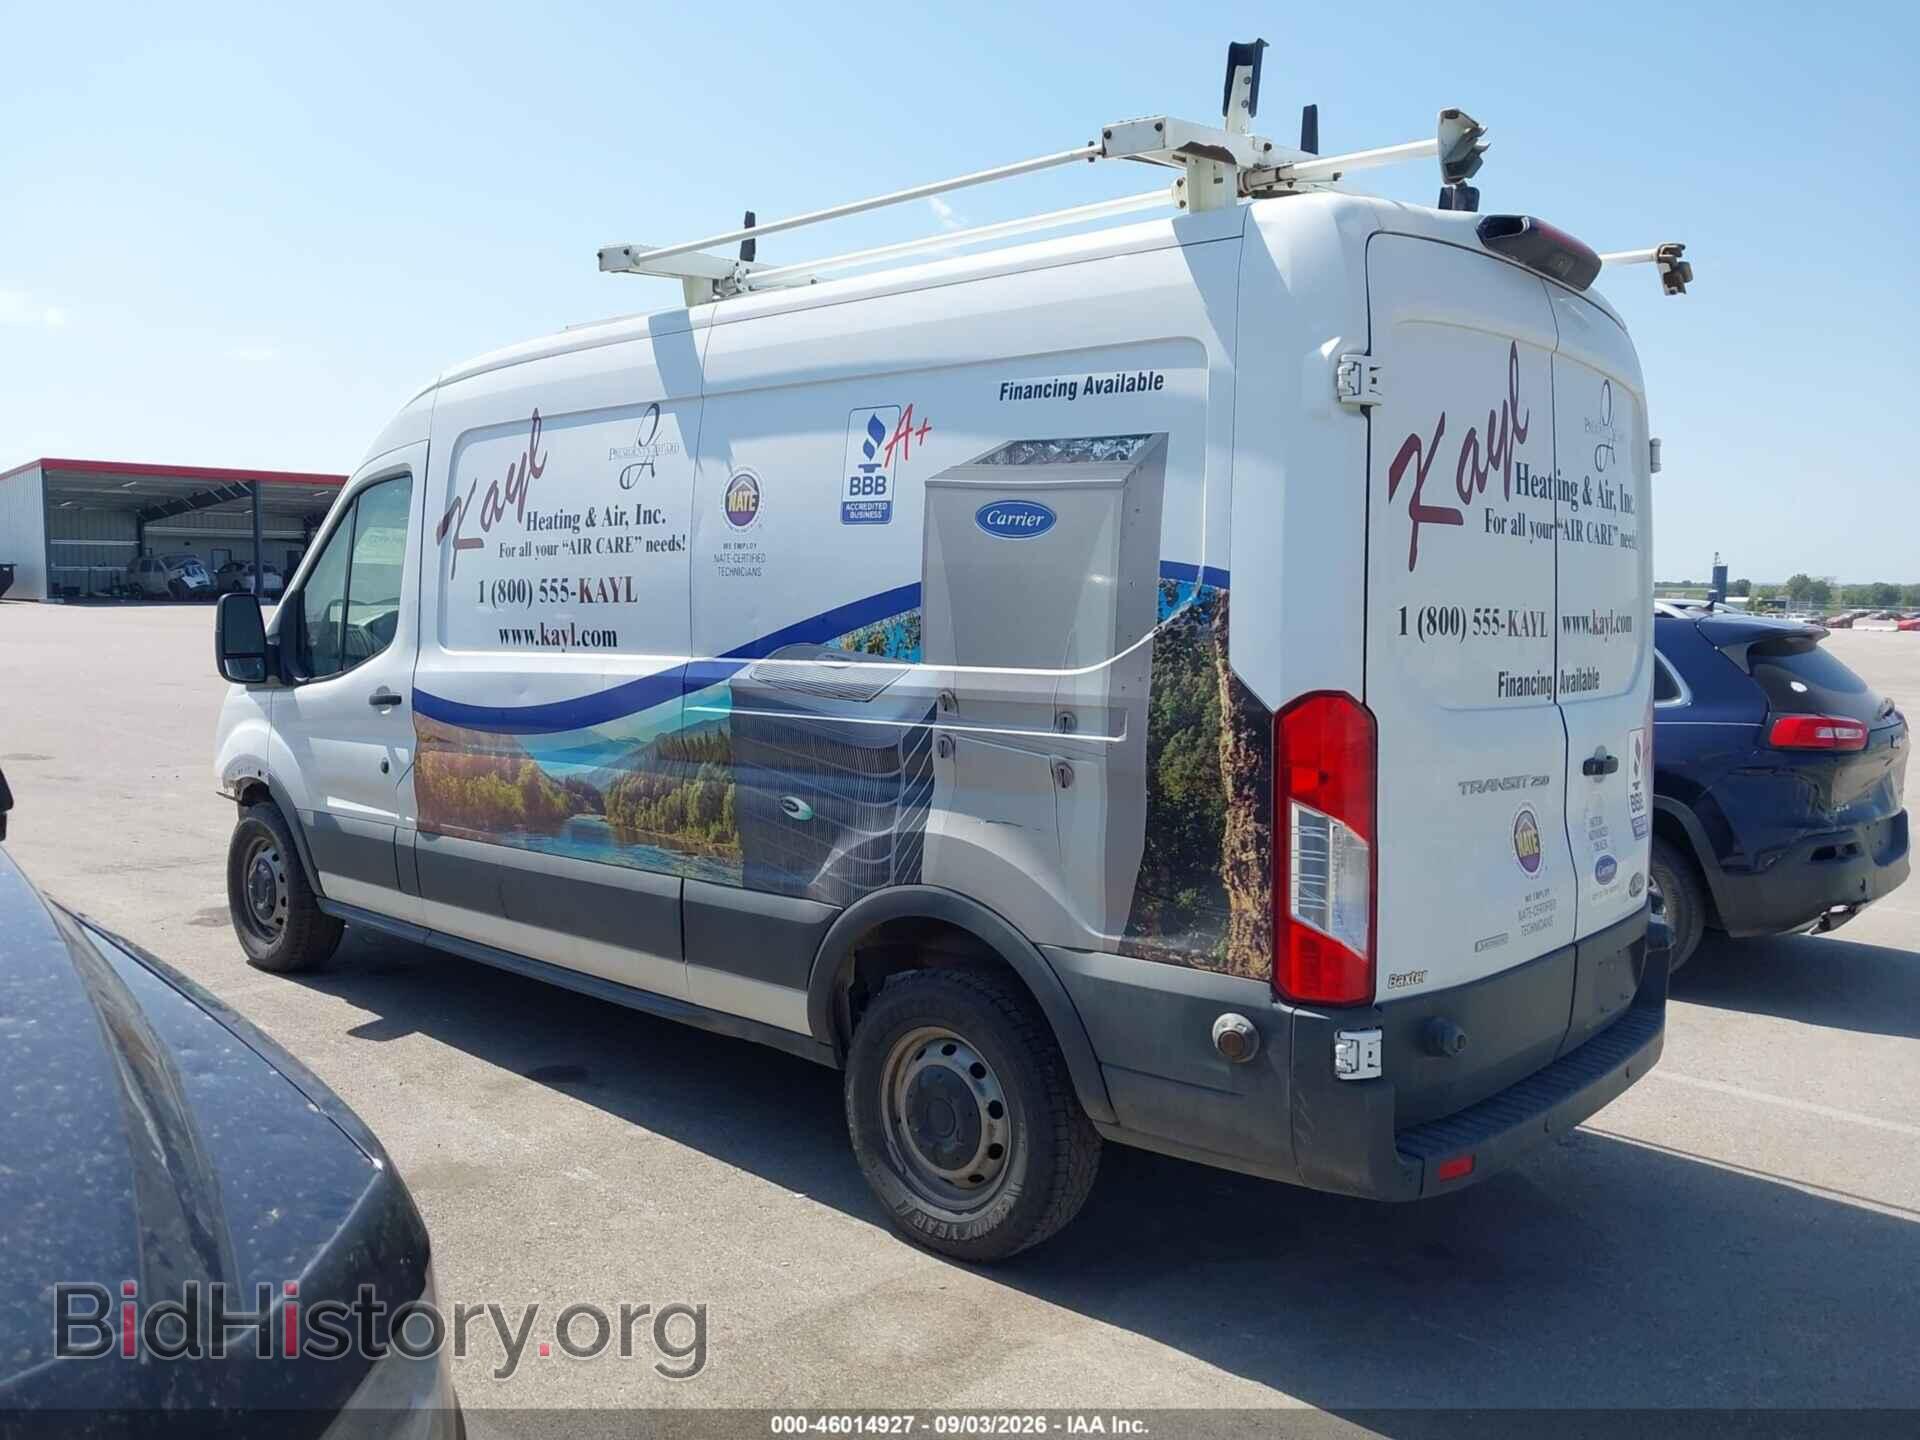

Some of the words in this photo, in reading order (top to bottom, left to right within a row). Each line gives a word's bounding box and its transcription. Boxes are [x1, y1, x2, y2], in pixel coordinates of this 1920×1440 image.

[1000, 380, 1078, 401] Financing
[1084, 371, 1164, 396] Available
[885, 403, 932, 468] A+
[1388, 339, 1530, 572] Kayl
[436, 407, 547, 580] Kayl
[849, 476, 887, 496] BBB
[1516, 461, 1578, 512] Heating
[1581, 475, 1592, 504] &
[1596, 479, 1617, 517] Air,
[1619, 483, 1636, 514] Inc
[728, 492, 757, 512] NATE
[846, 503, 887, 511] ACCREDITED
[849, 511, 882, 519] BUSINESS
[526, 509, 581, 534] Heating
[585, 508, 597, 528] &
[601, 506, 629, 530] Air,
[636, 503, 666, 525] Inc.
[987, 508, 1044, 528] Carrier
[1485, 507, 1505, 534] For
[1510, 512, 1525, 537] all
[1530, 521, 1554, 544] your
[499, 542, 516, 559] For
[518, 541, 532, 557] all
[534, 543, 559, 561] your
[645, 533, 686, 553] needs!
[718, 566, 762, 577] TECHNICIANS
[478, 580, 485, 603] 1
[491, 578, 533, 609] (800)
[539, 575, 639, 604] 555-KAYL
[499, 623, 618, 652] www.kayl.com
[1397, 605, 1408, 636] 1
[1417, 605, 1467, 643] (800)
[1472, 608, 1548, 638] 555-KAYL
[1562, 608, 1632, 642] www.kayl.com
[1498, 671, 1552, 700] Financing
[1559, 667, 1600, 694] Available
[1458, 776, 1530, 796] TRANSIT
[1387, 970, 1429, 990] Baxter
